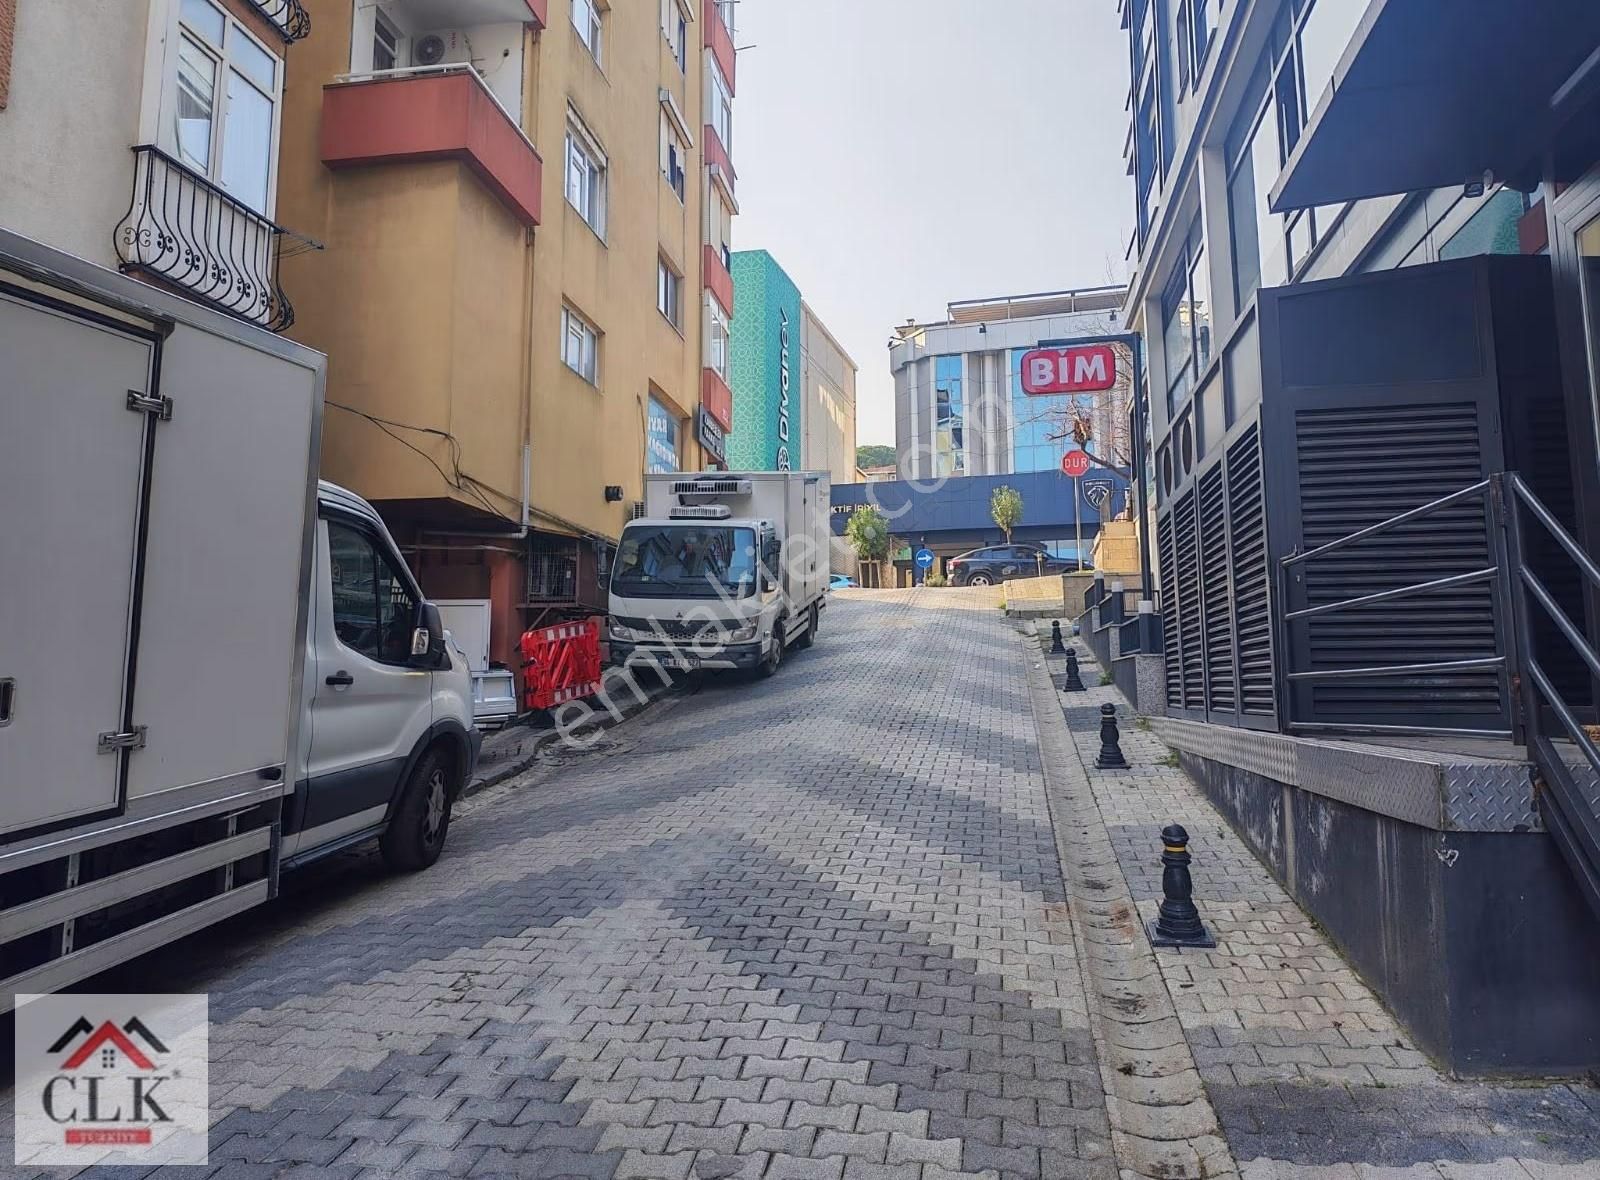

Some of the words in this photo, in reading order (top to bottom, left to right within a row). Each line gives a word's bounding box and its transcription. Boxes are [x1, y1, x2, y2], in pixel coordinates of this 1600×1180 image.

[779, 307, 789, 443] Divanev
[1030, 350, 1107, 386] BİM
[1064, 457, 1088, 469] DUR
